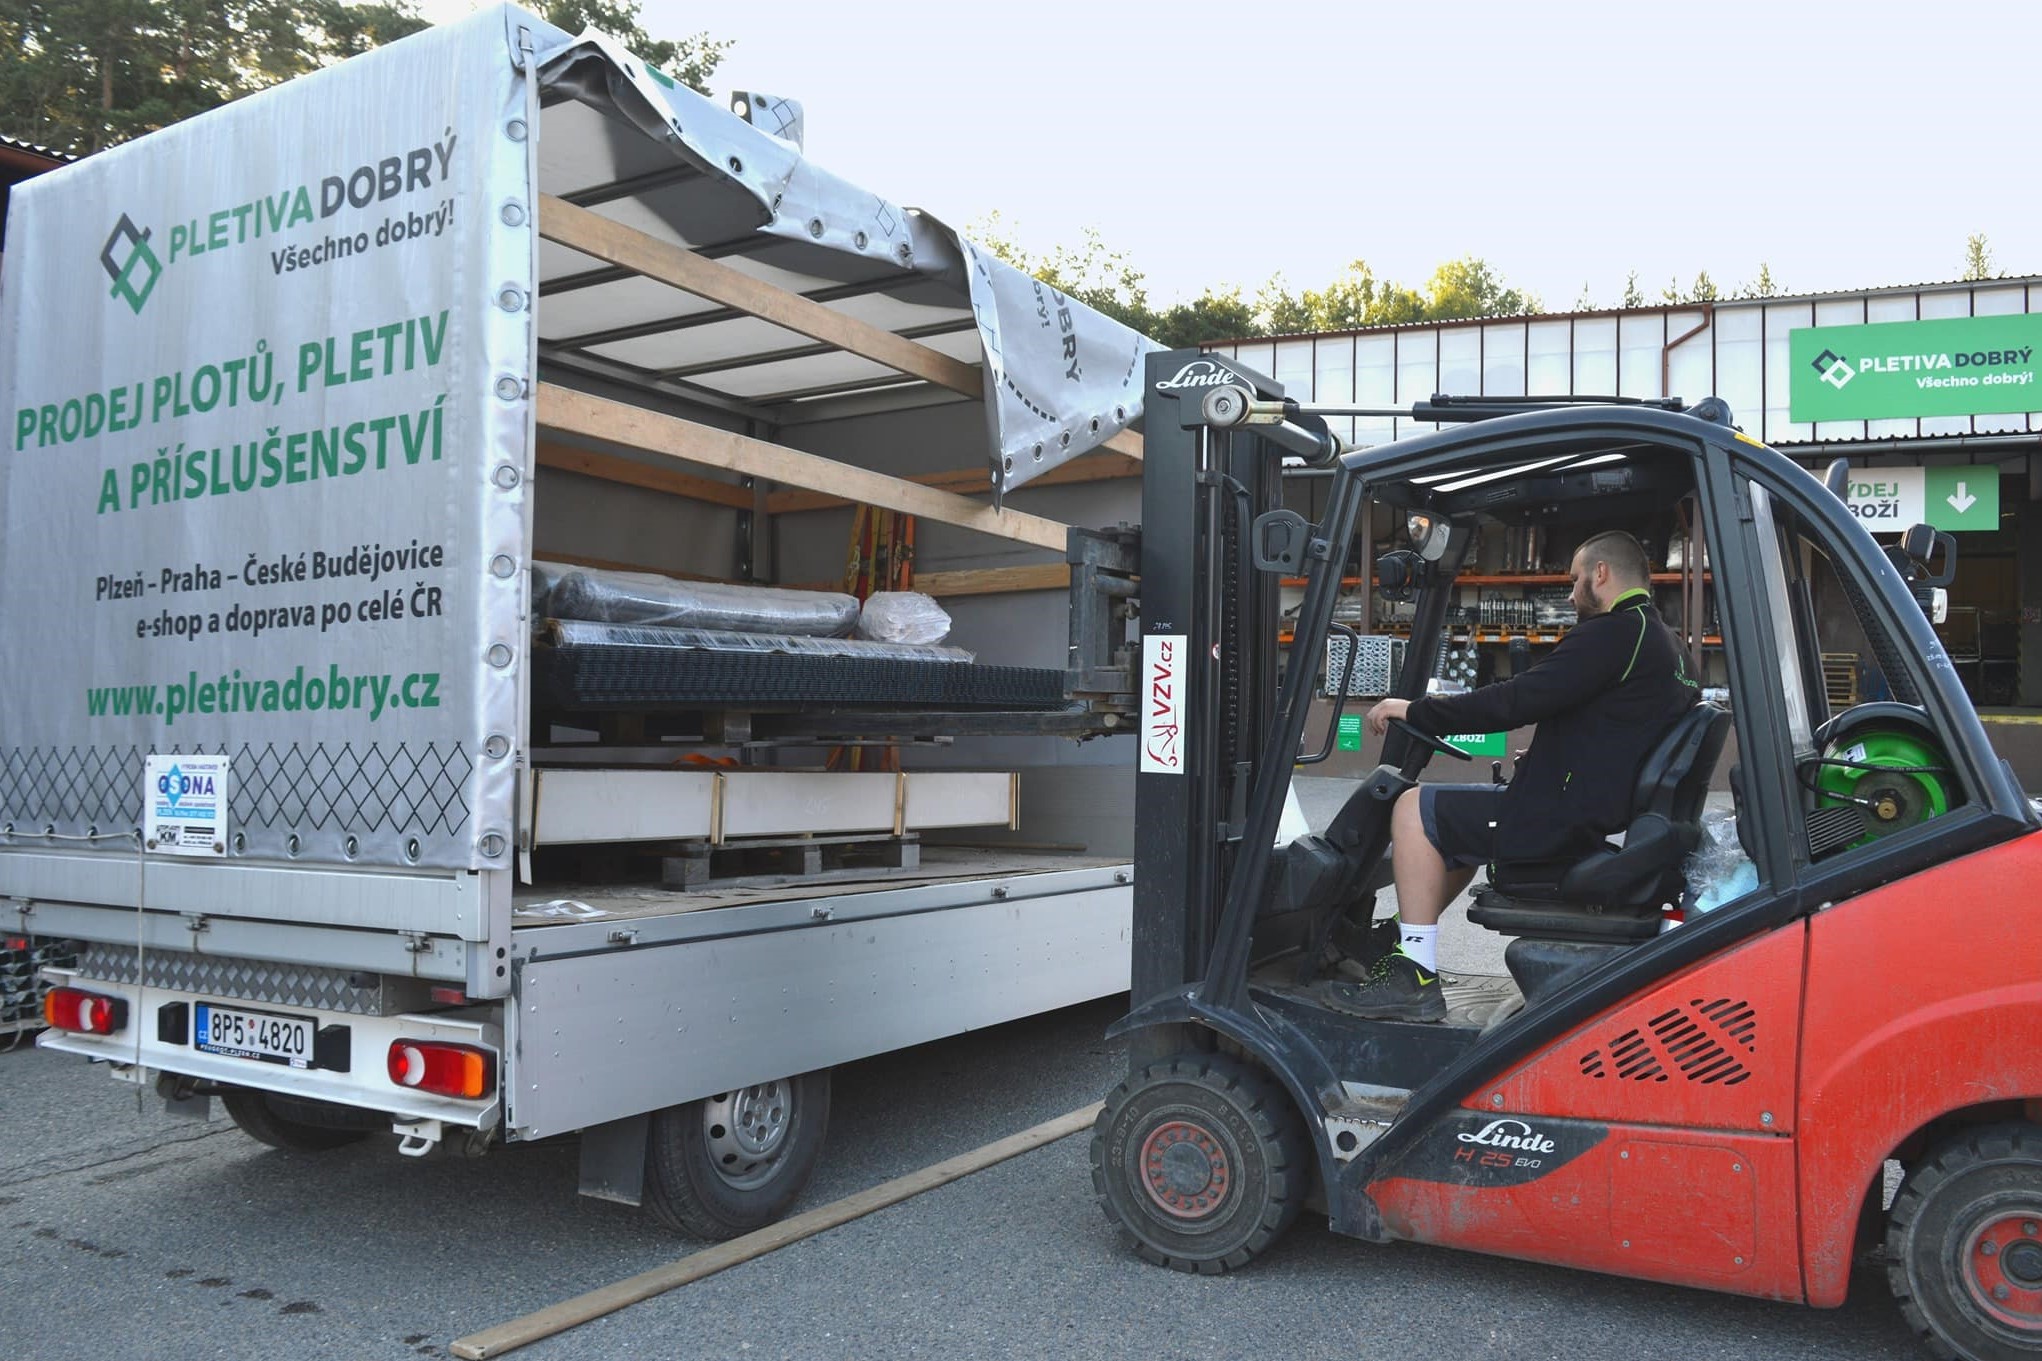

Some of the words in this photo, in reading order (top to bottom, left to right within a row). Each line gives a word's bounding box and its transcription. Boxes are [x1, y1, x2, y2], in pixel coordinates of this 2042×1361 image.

[169, 185, 314, 264] PLETIVA
[320, 126, 458, 219] DOBRÝ
[270, 235, 369, 275] Všechno
[375, 198, 456, 248] dobrý!
[15, 381, 144, 451] PRODEJ
[152, 338, 285, 424] PLOTŮ,
[297, 309, 450, 393] PLETIV
[1155, 360, 1235, 390] Linde
[1859, 353, 1952, 373] PLETIVA
[1954, 346, 2033, 368] DOBRÝ
[1916, 374, 1980, 389] Všechno
[1982, 371, 2034, 386] dobrý!
[96, 468, 121, 514] A
[130, 393, 447, 507] PŘÍSLUŠENSTVÍ
[95, 570, 145, 602] Plzeň
[160, 563, 222, 595] Praha
[243, 551, 307, 587] České
[311, 538, 444, 583] Budějovice
[136, 608, 203, 642] e-shop
[207, 612, 220, 634] a
[225, 602, 316, 638] doprava
[320, 602, 353, 633] po
[356, 588, 405, 623] celé
[409, 580, 444, 618] ČR
[86, 663, 441, 726] www.pletivadobry.cz
[1152, 640, 1173, 718] VZV.cz
[158, 774, 215, 796] OSONA
[212, 1012, 244, 1046] 8P5
[258, 1019, 305, 1056] 4820
[1453, 1146, 1476, 1163] H
[1479, 1151, 1514, 1168] 25
[1514, 1157, 1542, 1169] EVO
[1456, 1119, 1556, 1153] Linde
